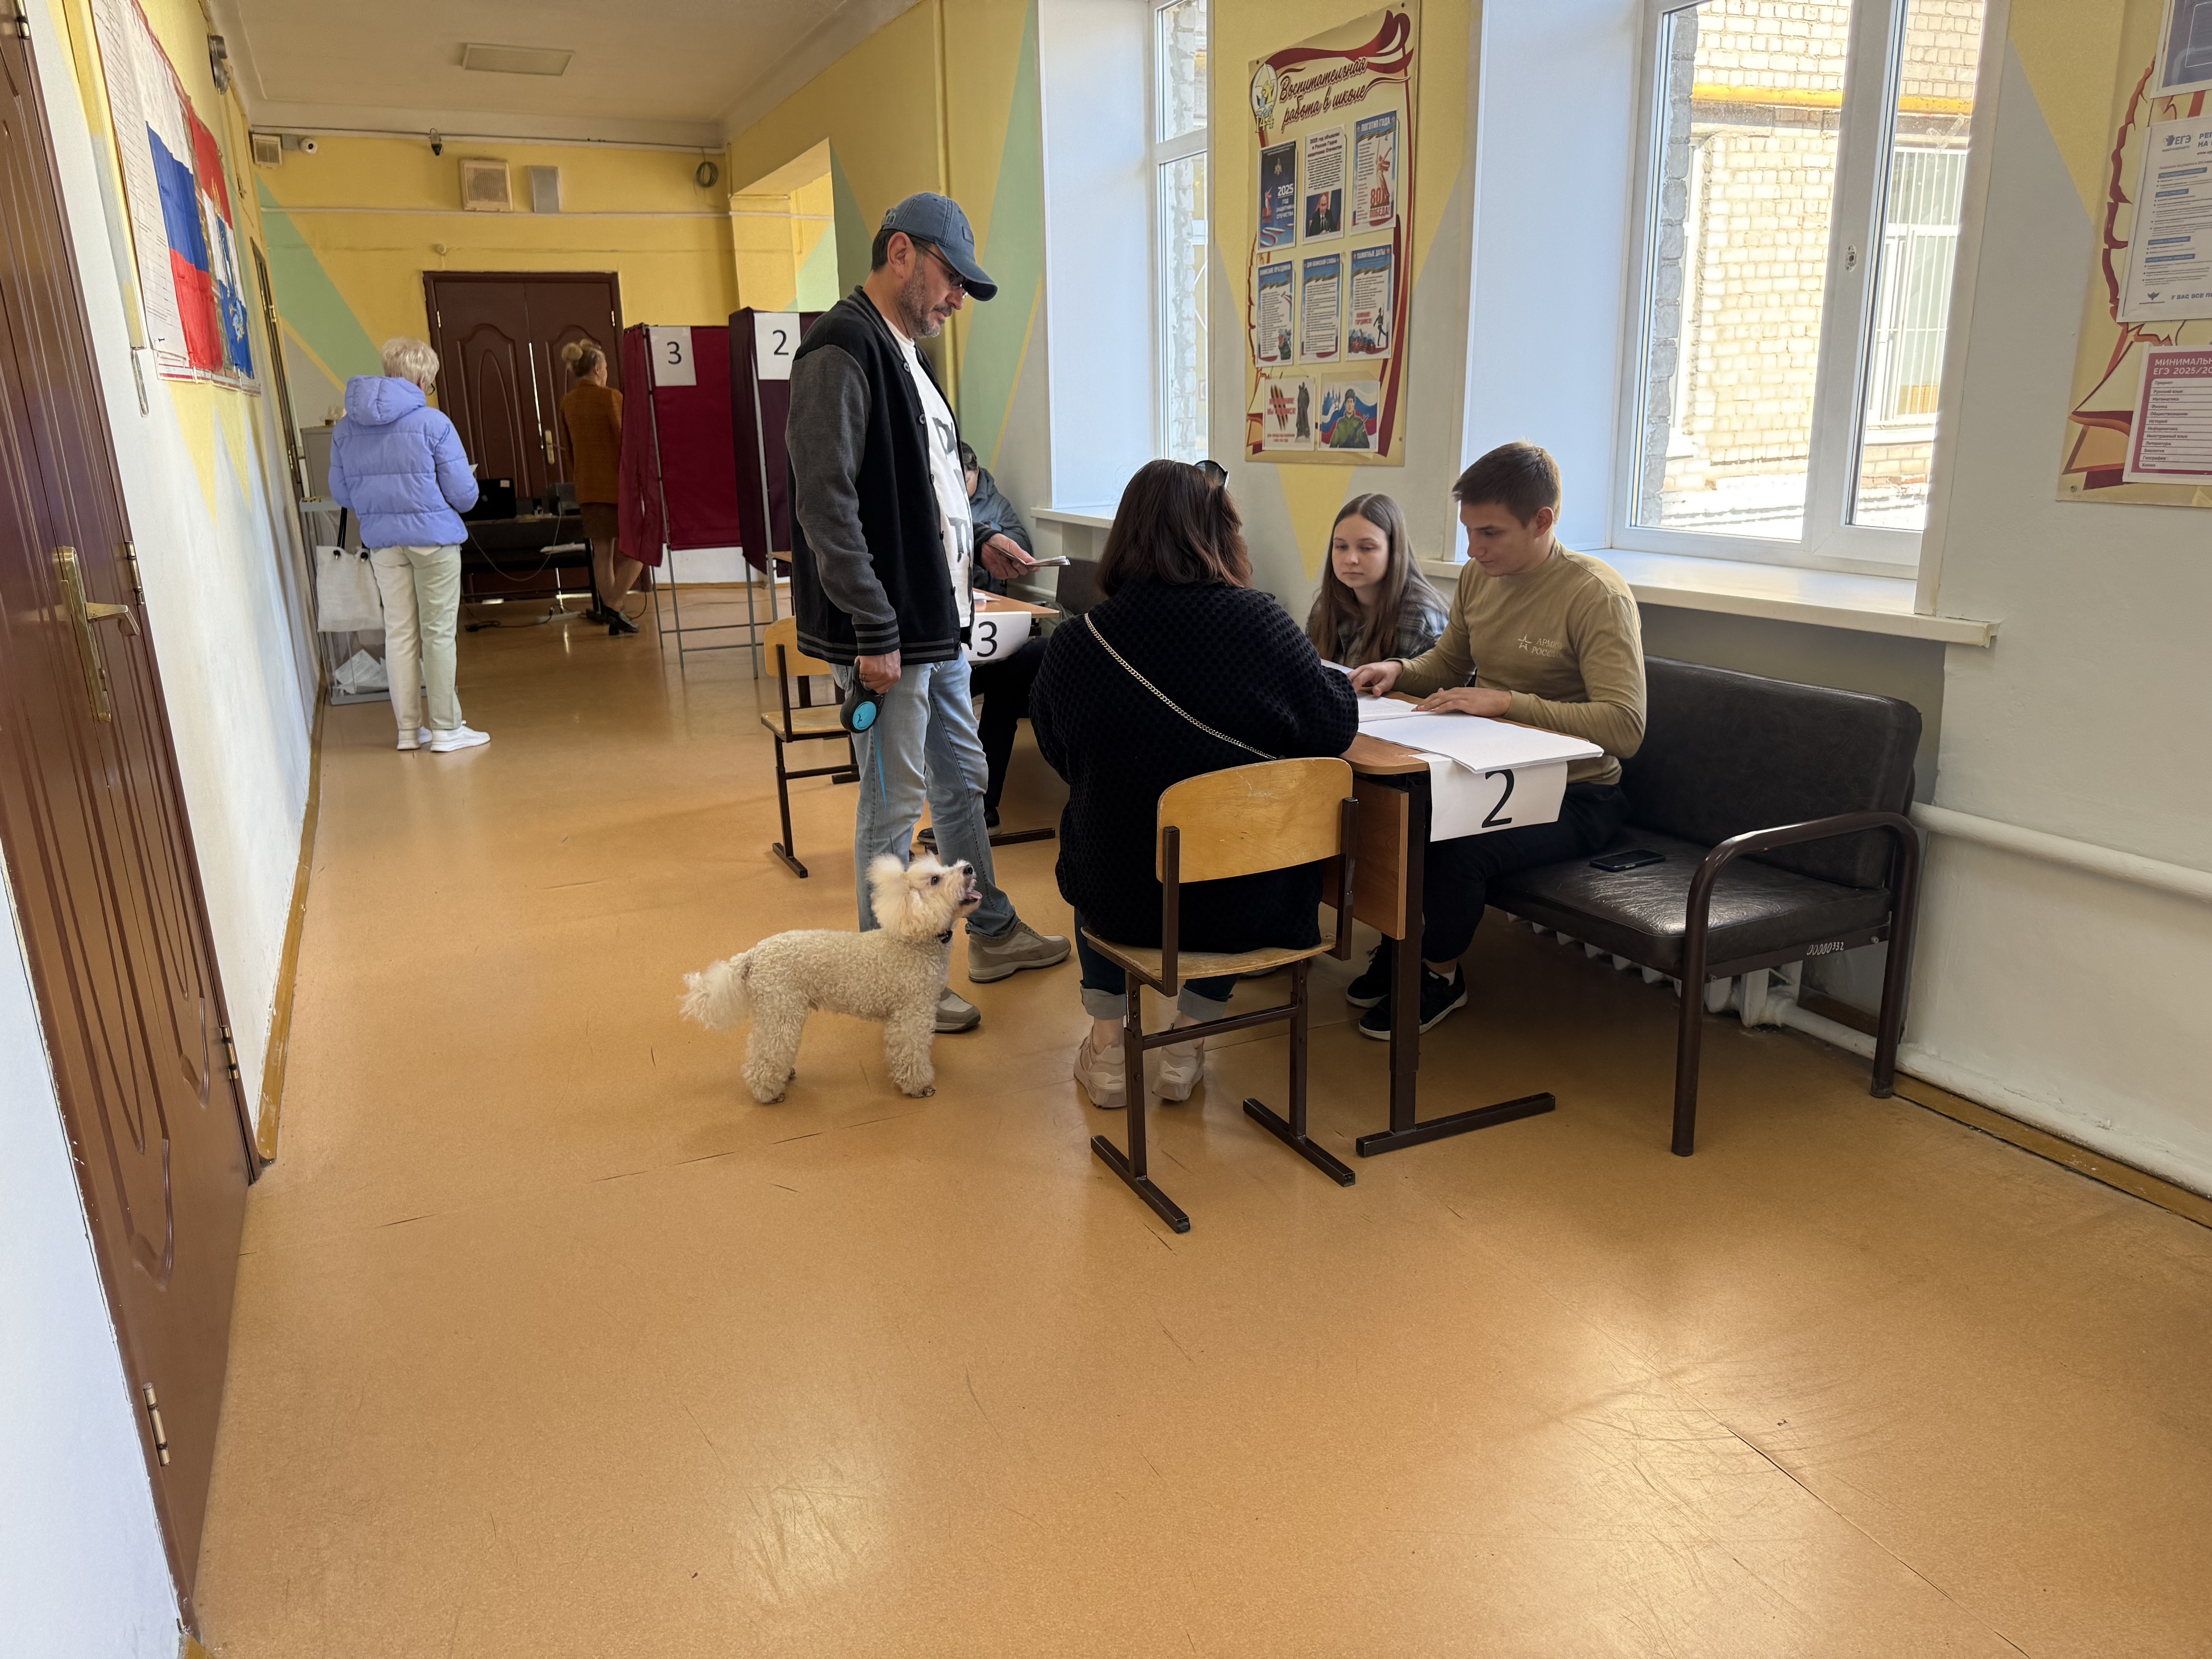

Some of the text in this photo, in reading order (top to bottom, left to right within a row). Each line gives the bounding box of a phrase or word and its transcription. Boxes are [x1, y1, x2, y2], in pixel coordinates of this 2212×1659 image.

[1279, 58, 1367, 101] Воспитательная
[1281, 84, 1368, 134] работа в школе
[1255, 110, 1274, 133] 144
[2175, 135, 2191, 145] ЕГЭ
[1278, 183, 1294, 196] 2025
[1370, 187, 1381, 206] 80
[1369, 206, 1390, 218] ПОБЕДА!
[667, 341, 682, 364] 3
[773, 330, 789, 355] 2
[977, 621, 997, 657] 3
[1481, 769, 1514, 828] 2
